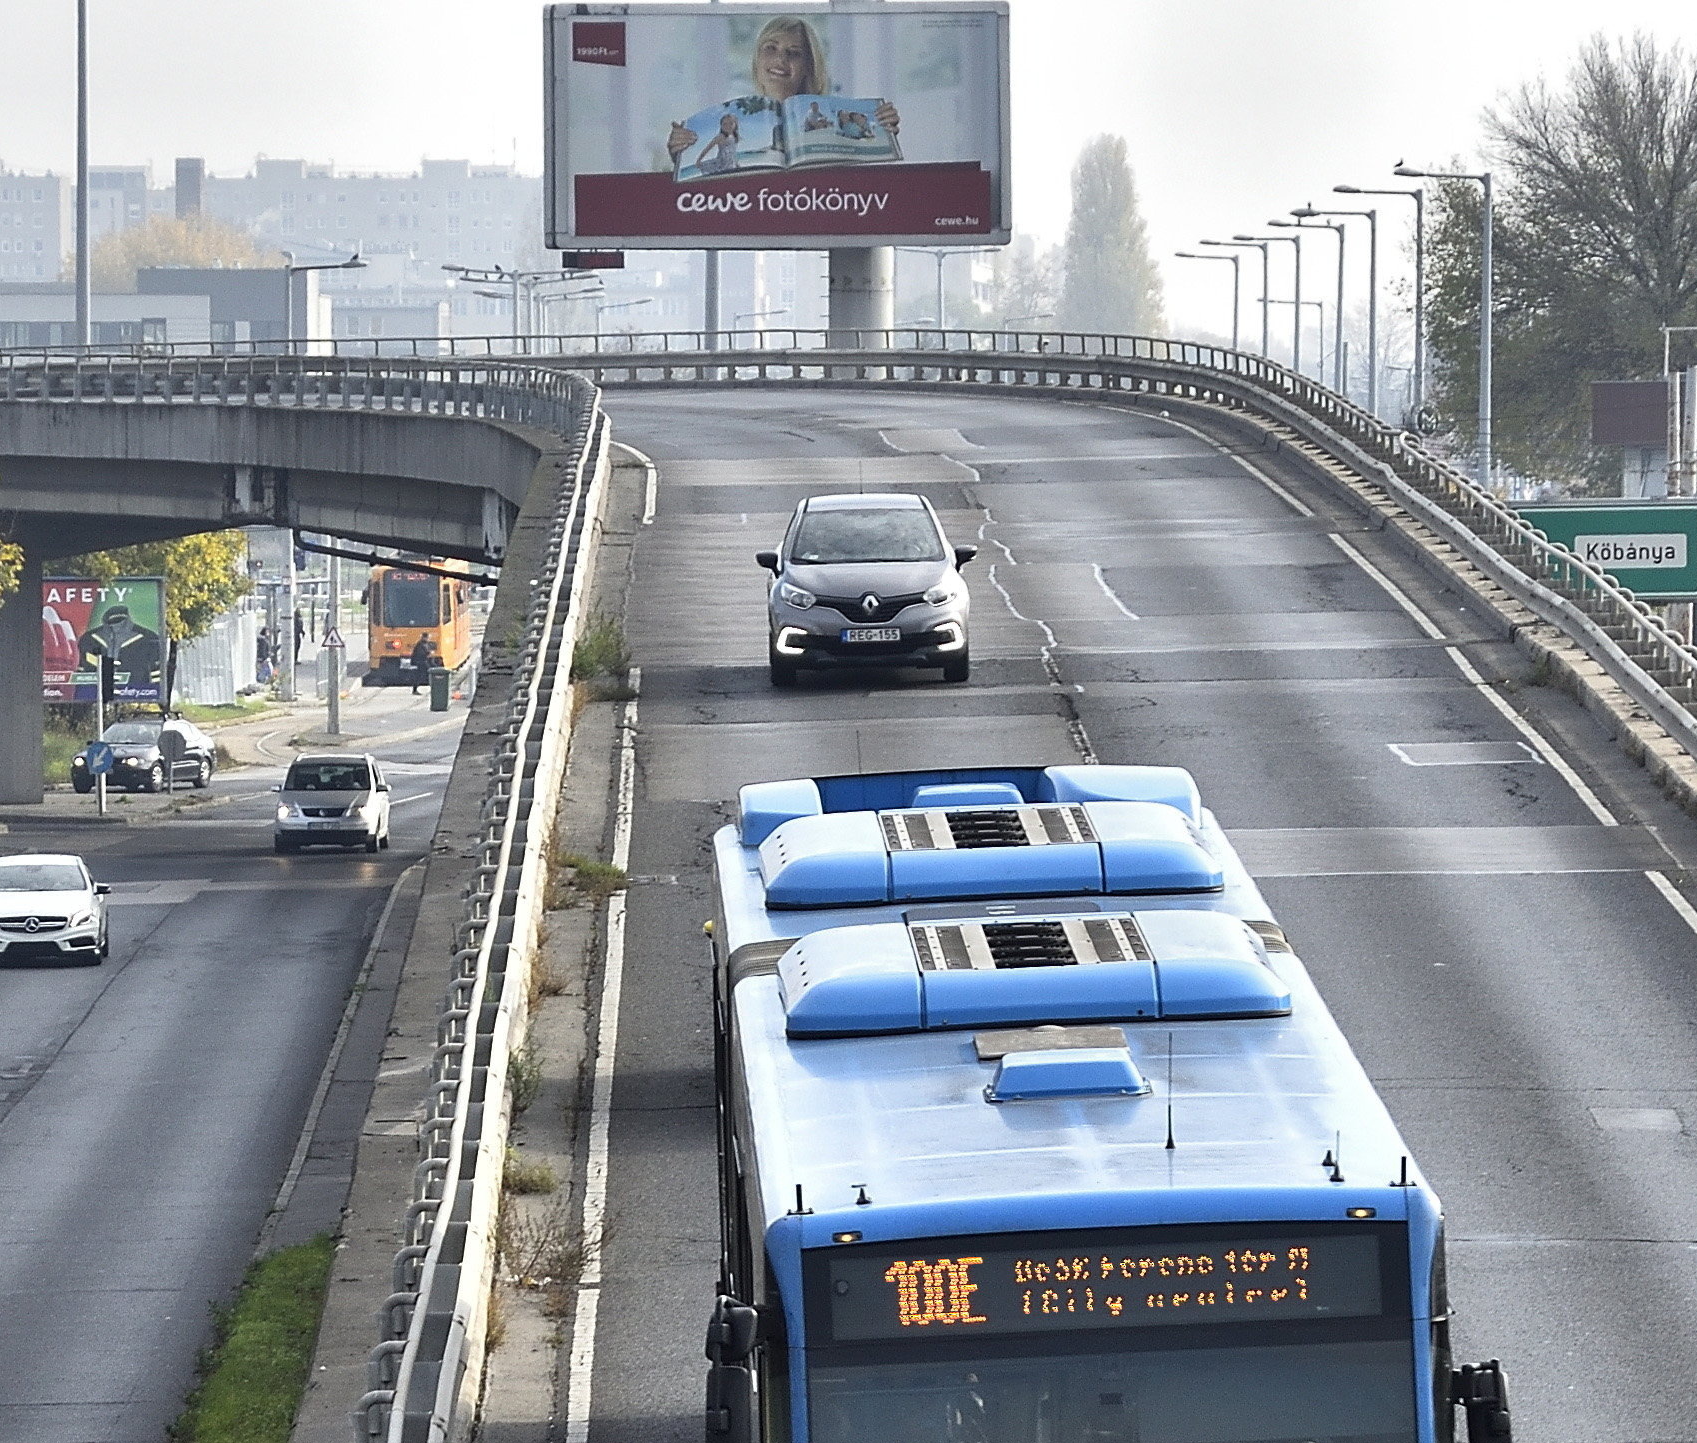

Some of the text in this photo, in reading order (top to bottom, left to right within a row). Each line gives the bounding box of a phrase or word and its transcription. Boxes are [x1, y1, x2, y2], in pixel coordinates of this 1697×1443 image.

[677, 187, 889, 216] cewe fotókönyv
[935, 215, 979, 226] cewe.hu
[47, 588, 127, 603] AFETY
[850, 629, 898, 641] REG-155
